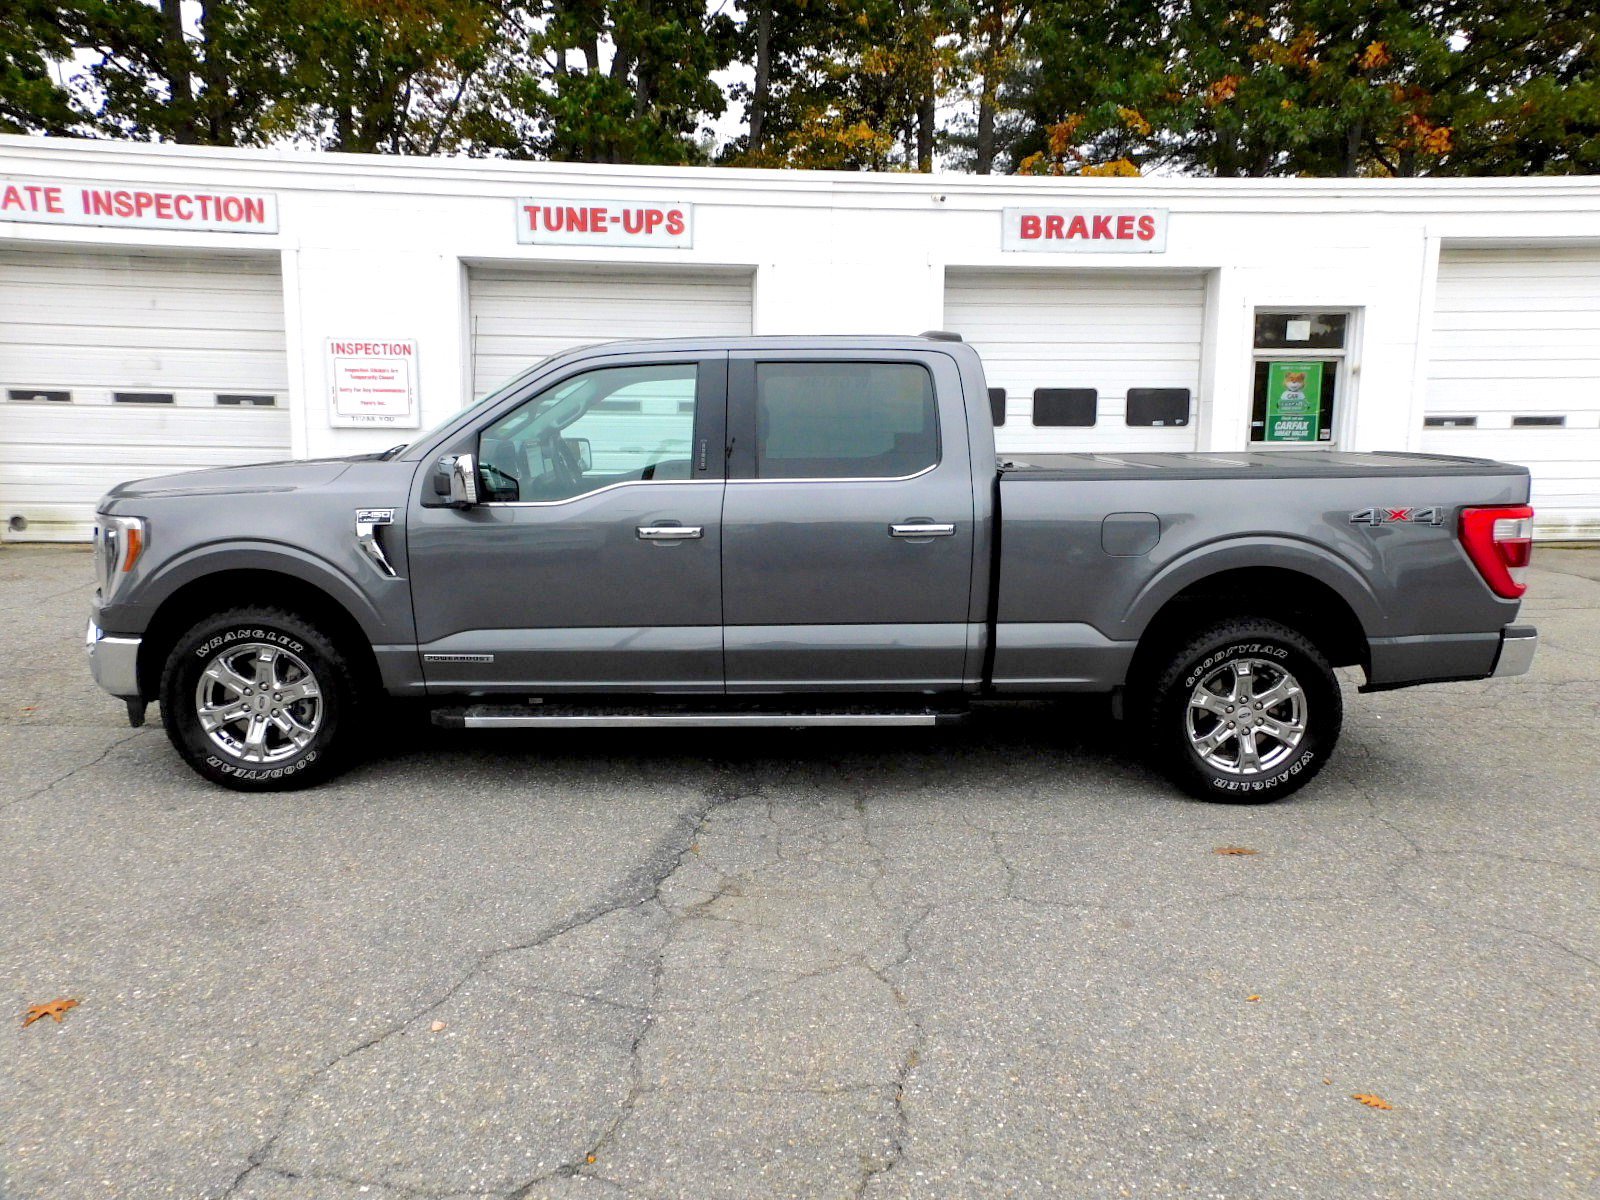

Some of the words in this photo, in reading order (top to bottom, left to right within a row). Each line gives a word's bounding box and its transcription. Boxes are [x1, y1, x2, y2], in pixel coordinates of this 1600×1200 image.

[1, 185, 64, 213] ATE
[81, 189, 264, 223] INSPECTION
[523, 205, 685, 235] TUNE-UPS
[1020, 215, 1155, 240] BRAKES
[331, 342, 411, 355] INSPECTION
[1275, 421, 1309, 429] CARFAX
[196, 629, 303, 658] WRANGLER
[1186, 643, 1288, 687] GOODYEAR
[206, 750, 317, 780] GOODYEAR
[1213, 751, 1314, 791] WRANGLER
